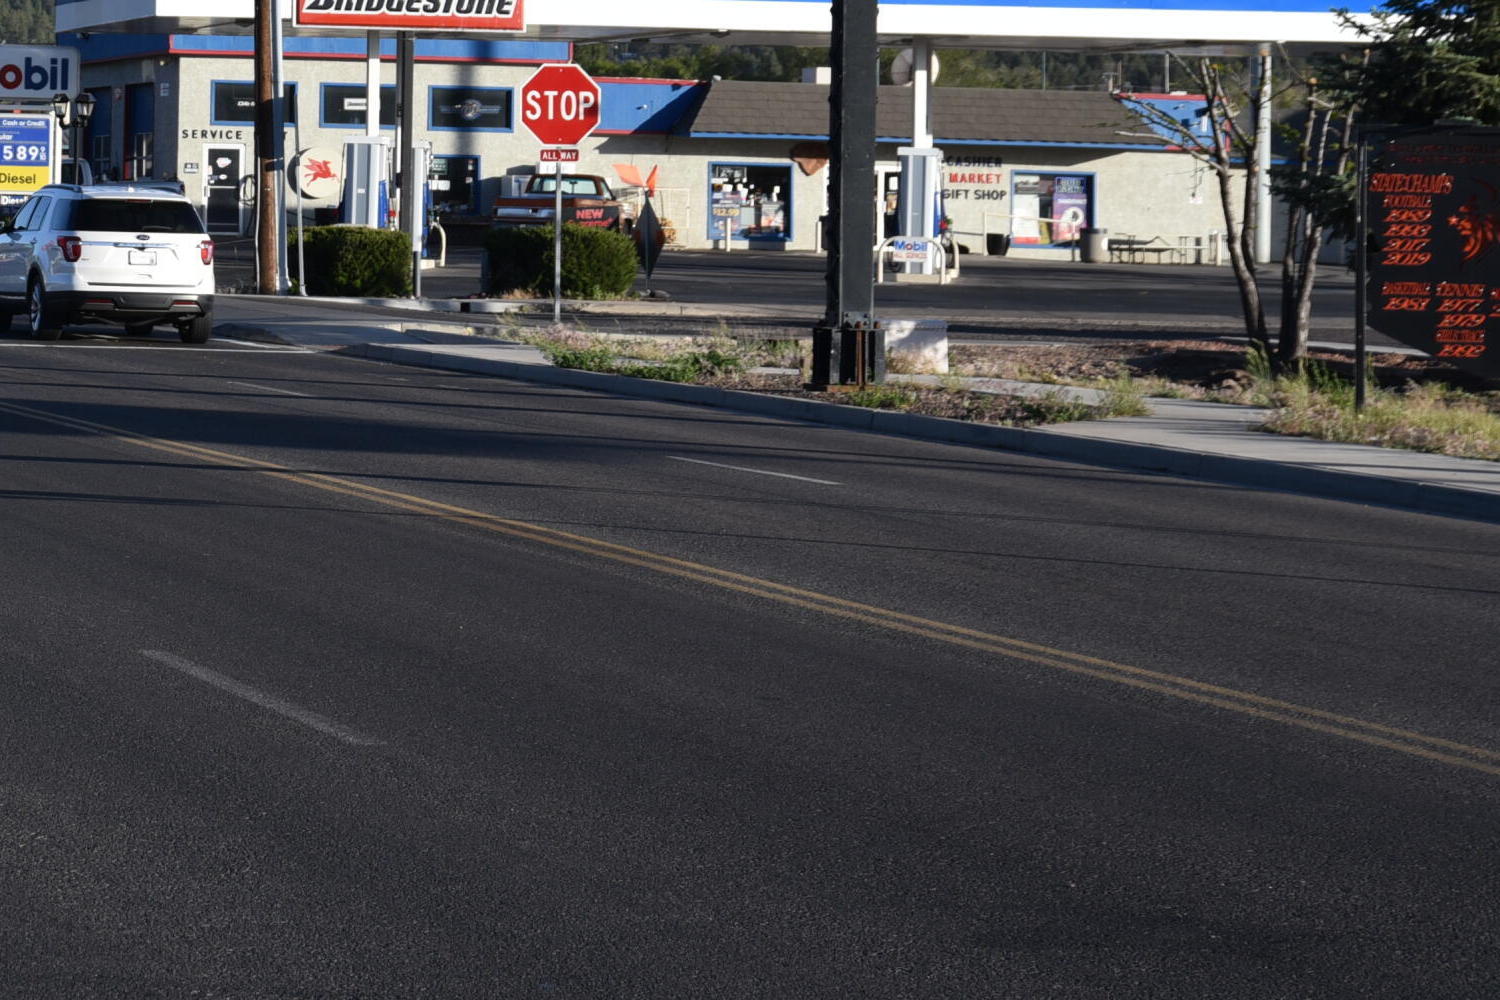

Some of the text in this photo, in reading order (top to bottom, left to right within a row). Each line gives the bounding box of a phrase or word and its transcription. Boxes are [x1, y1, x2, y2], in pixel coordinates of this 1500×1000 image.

[525, 89, 595, 121] STOP
[182, 129, 243, 140] SERVICE
[542, 152, 577, 160] ALL WAY
[946, 155, 1003, 168] CASHIER
[948, 172, 1003, 184] MARKET
[1369, 172, 1454, 195] STATE CHAMPS
[940, 188, 1007, 201] GIFT SHOP
[1383, 195, 1433, 208] FOOTBALL
[576, 208, 604, 220] NEW
[894, 240, 928, 251] Mobil
[1382, 238, 1433, 251] 2017
[1381, 252, 1432, 266] 2019
[1436, 283, 1486, 297] TENNIS
[1383, 297, 1485, 312] 1981 1977
[1436, 313, 1487, 328] 1979
